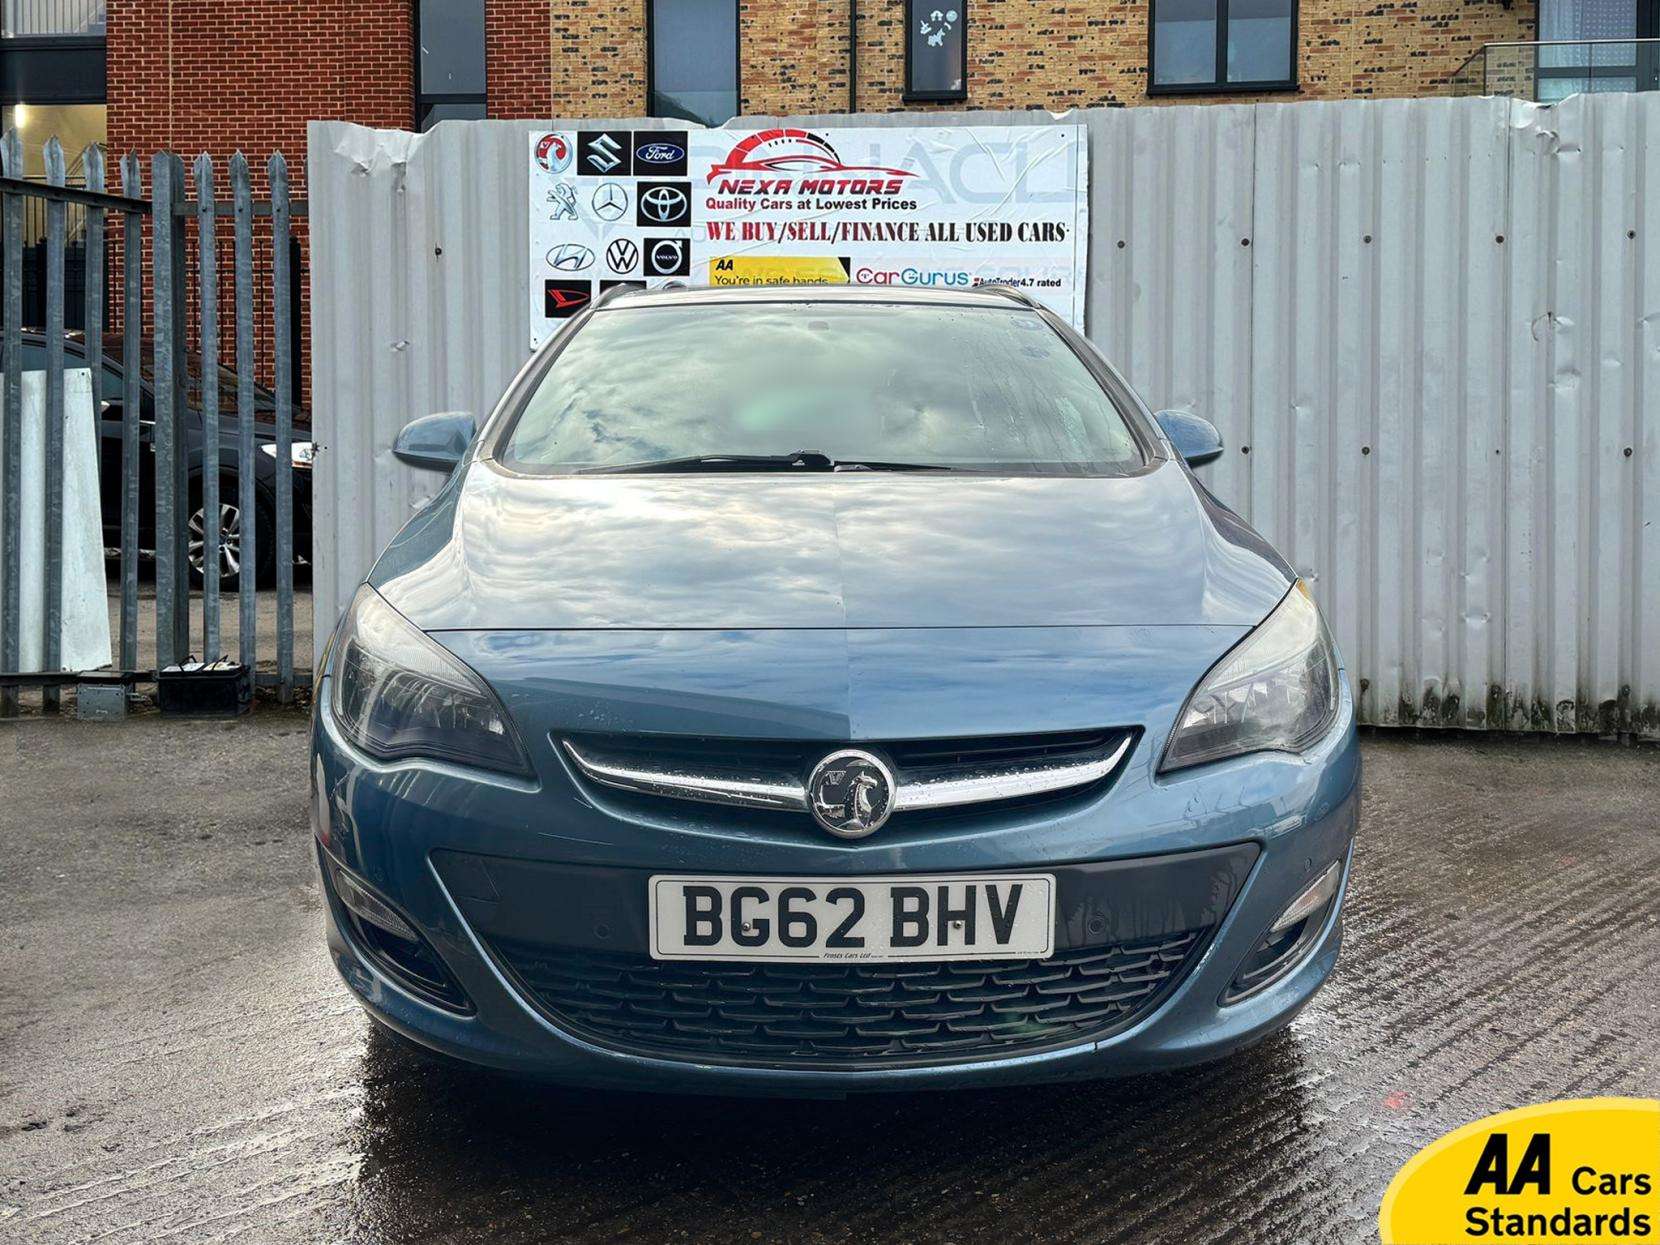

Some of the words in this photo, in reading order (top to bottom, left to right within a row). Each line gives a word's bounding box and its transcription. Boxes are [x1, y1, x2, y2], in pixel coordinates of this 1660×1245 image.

[645, 144, 675, 160] Ford
[718, 179, 793, 195] NEXA
[799, 179, 904, 195] MOTORS
[706, 197, 756, 212] Quality
[761, 197, 793, 210] Cars
[797, 198, 811, 210] at
[816, 197, 867, 210] Lowest
[872, 197, 918, 210] Prices
[706, 221, 736, 241] WE
[925, 222, 959, 242] ALL
[965, 222, 1013, 242] USED
[1018, 222, 1066, 242] CARS
[715, 259, 734, 271] AA
[715, 275, 750, 286] You're
[753, 275, 763, 285] in
[766, 275, 790, 285] safe
[856, 267, 969, 286] CarGurus
[1037, 278, 1061, 287] rated
[683, 885, 865, 948] BG62
[890, 884, 1023, 947] BHV
